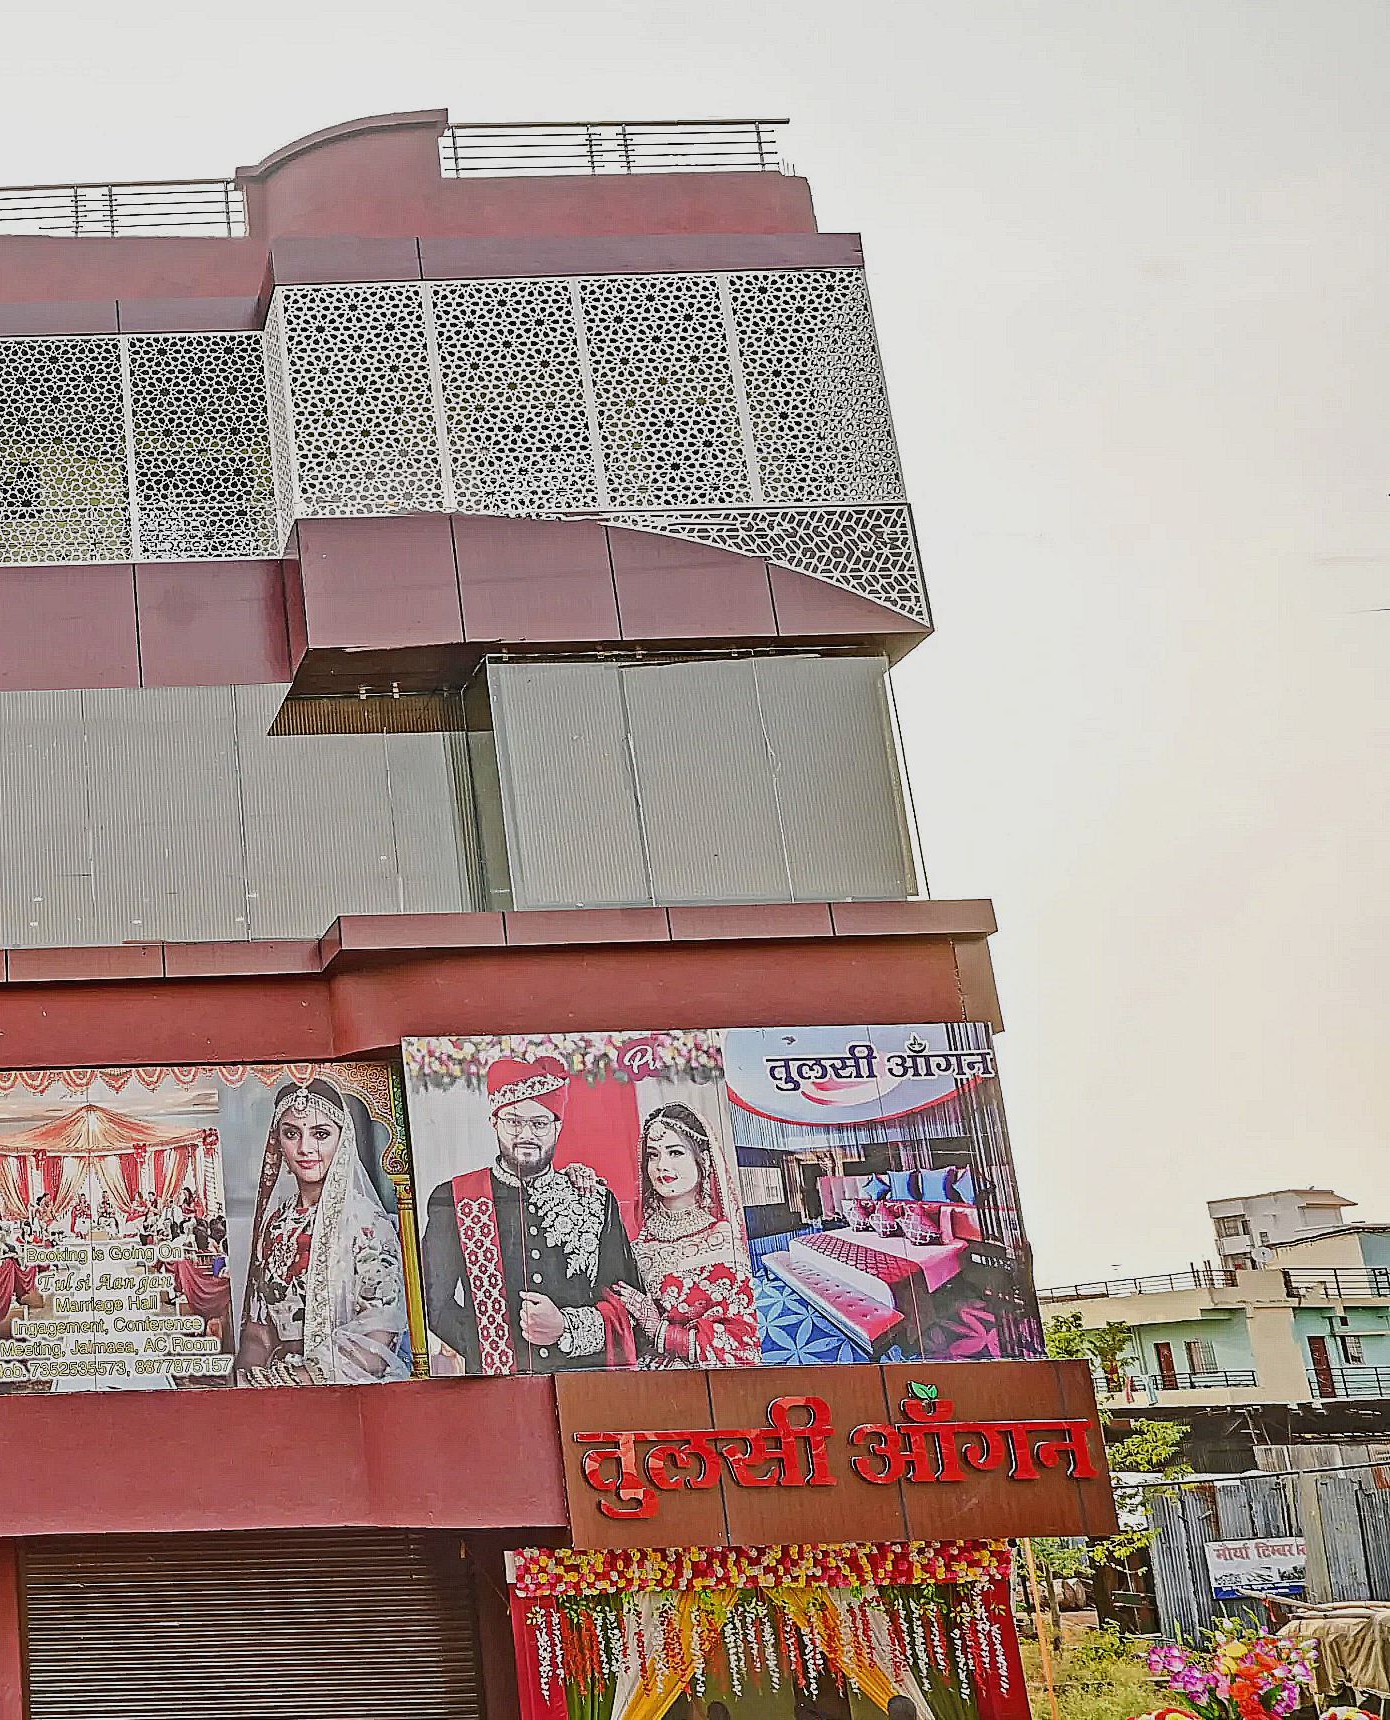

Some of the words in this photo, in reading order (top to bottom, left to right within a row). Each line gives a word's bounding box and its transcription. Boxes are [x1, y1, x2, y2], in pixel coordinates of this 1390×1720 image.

[765, 1044, 878, 1091] तुलसी
[26, 1248, 89, 1264] Booking
[92, 1247, 104, 1260] is
[109, 1246, 154, 1262] Going
[159, 1244, 182, 1258] On
[56, 1297, 123, 1314] Marriage
[128, 1296, 158, 1311] Hall
[113, 1316, 202, 1332] Conference
[0, 1340, 66, 1358] Meeting,
[144, 1337, 168, 1352] AC
[173, 1337, 218, 1352] Room
[575, 1397, 836, 1518] तुलसी
